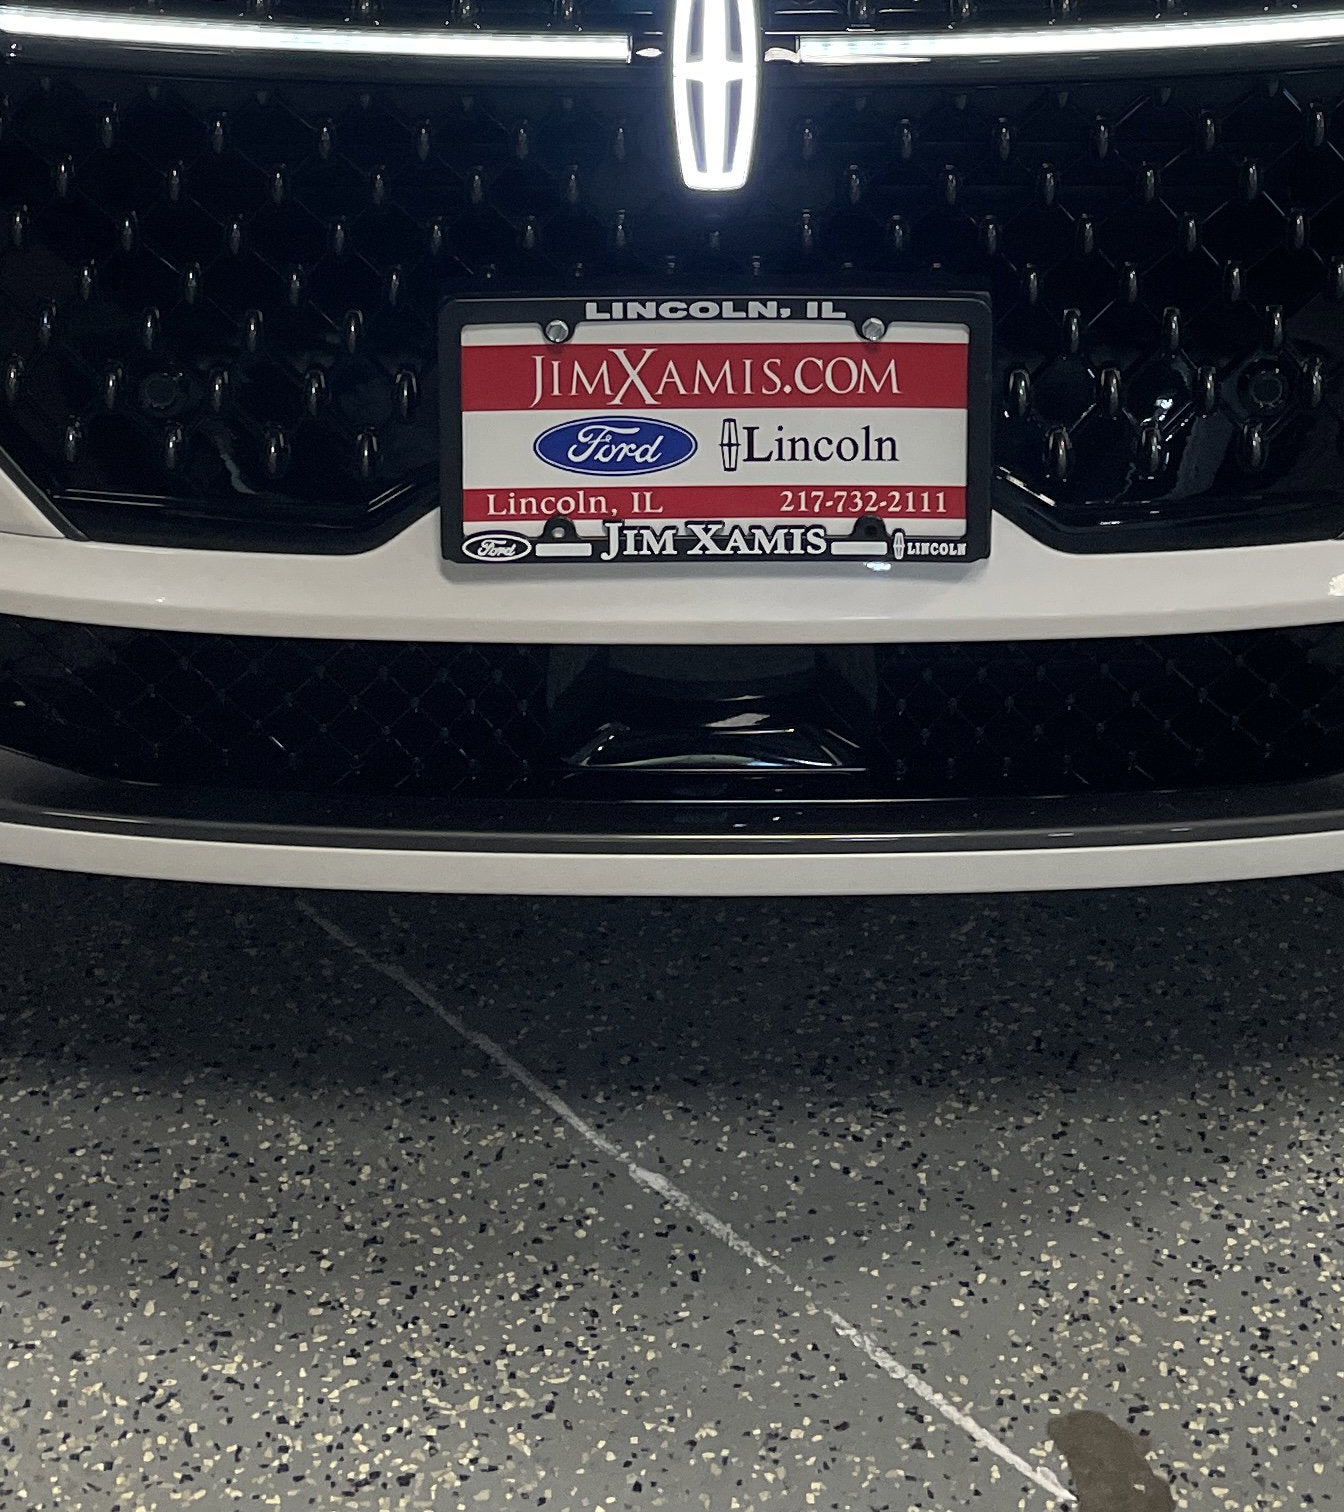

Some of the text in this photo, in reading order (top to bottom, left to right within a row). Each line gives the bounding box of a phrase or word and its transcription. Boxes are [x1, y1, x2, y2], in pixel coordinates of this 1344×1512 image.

[585, 300, 848, 321] LINCOLN, IL
[529, 348, 902, 408] JIMXAMIS.COM
[567, 424, 665, 463] Ford
[742, 424, 900, 463] Lincoln
[486, 490, 664, 517] Lincoln, IL
[780, 490, 948, 514] 217-732-2111
[476, 539, 516, 557] Ford
[600, 521, 827, 561] JIM XAMIS
[907, 542, 967, 556] LINCOLN
